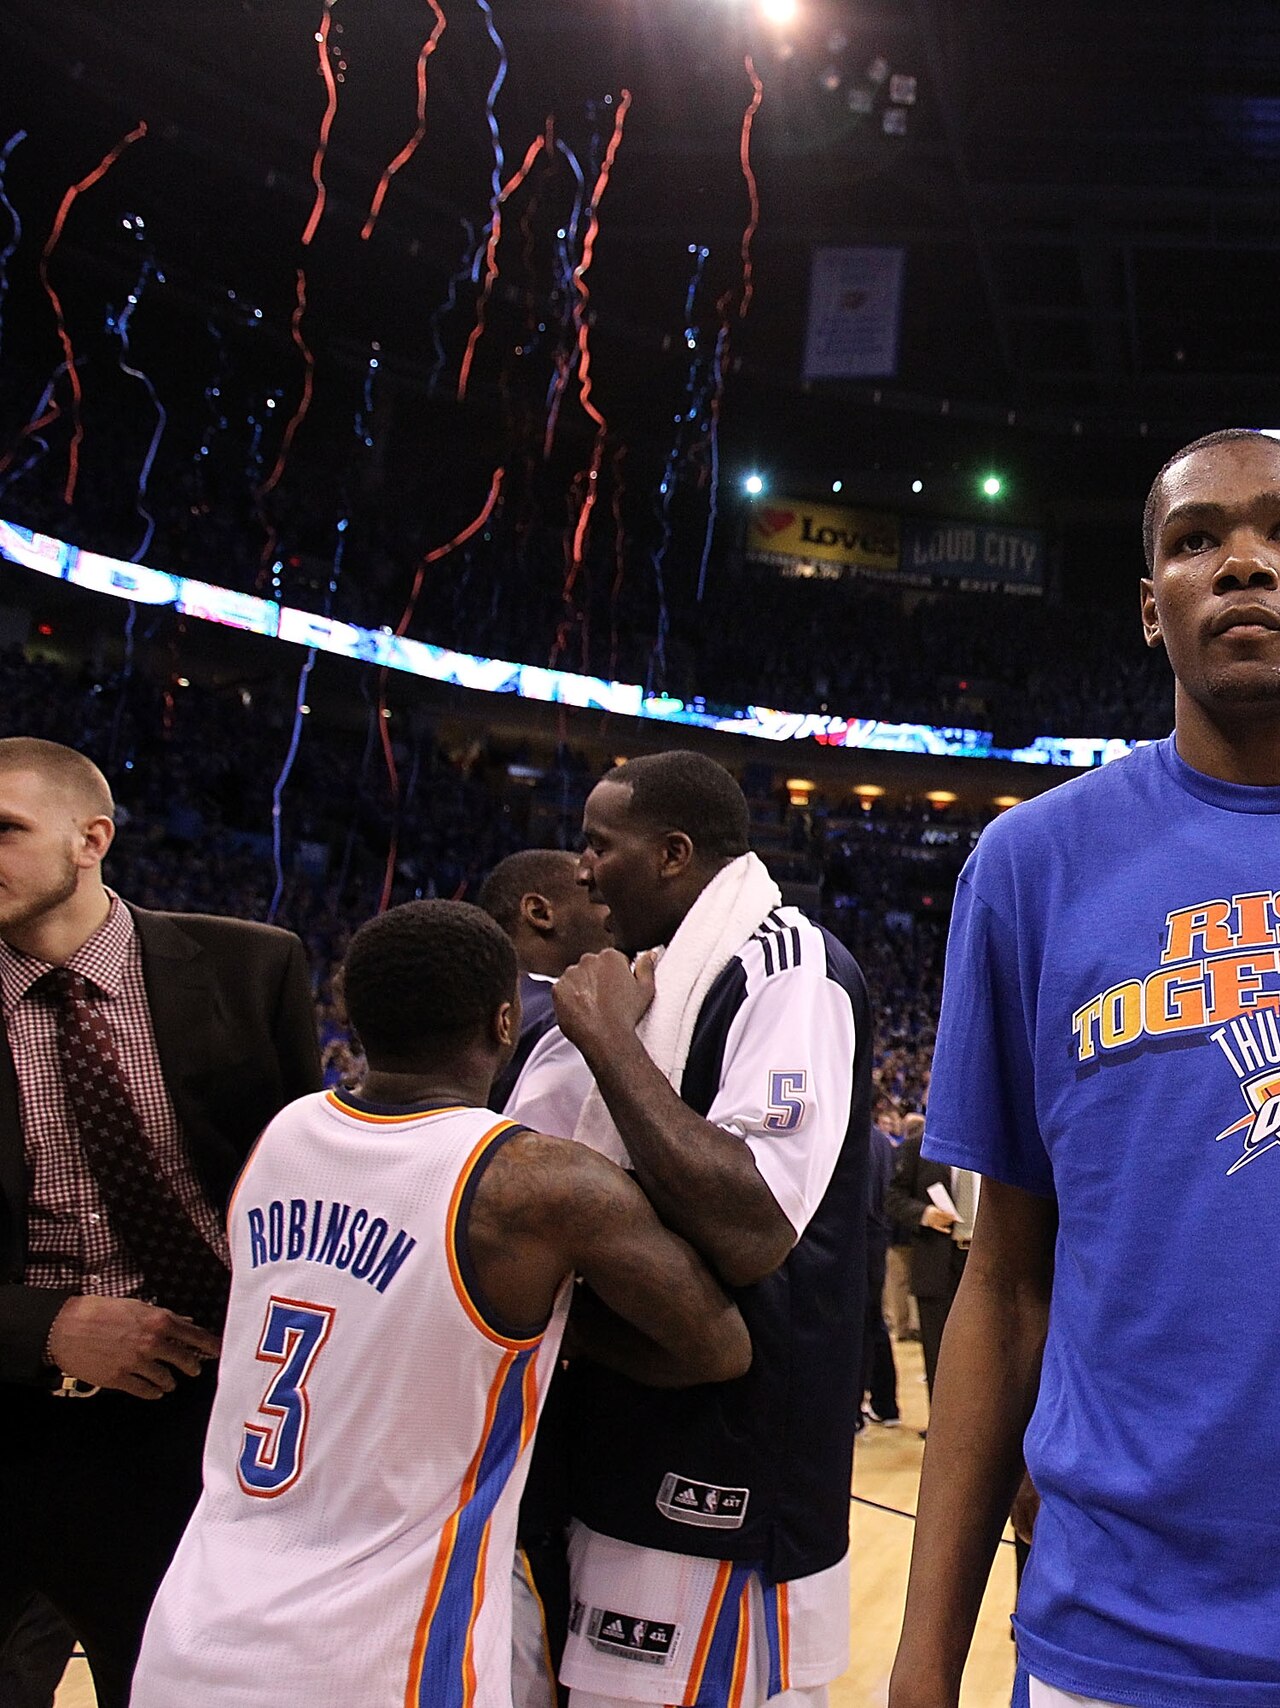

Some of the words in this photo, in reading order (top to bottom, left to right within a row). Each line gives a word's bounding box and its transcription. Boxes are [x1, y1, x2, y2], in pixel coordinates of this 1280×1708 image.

[912, 528, 976, 566] LOUD
[983, 531, 1038, 576] CITY
[763, 1069, 807, 1132] 5
[247, 1198, 418, 1295] ROBINSON
[236, 1294, 337, 1500] 3
